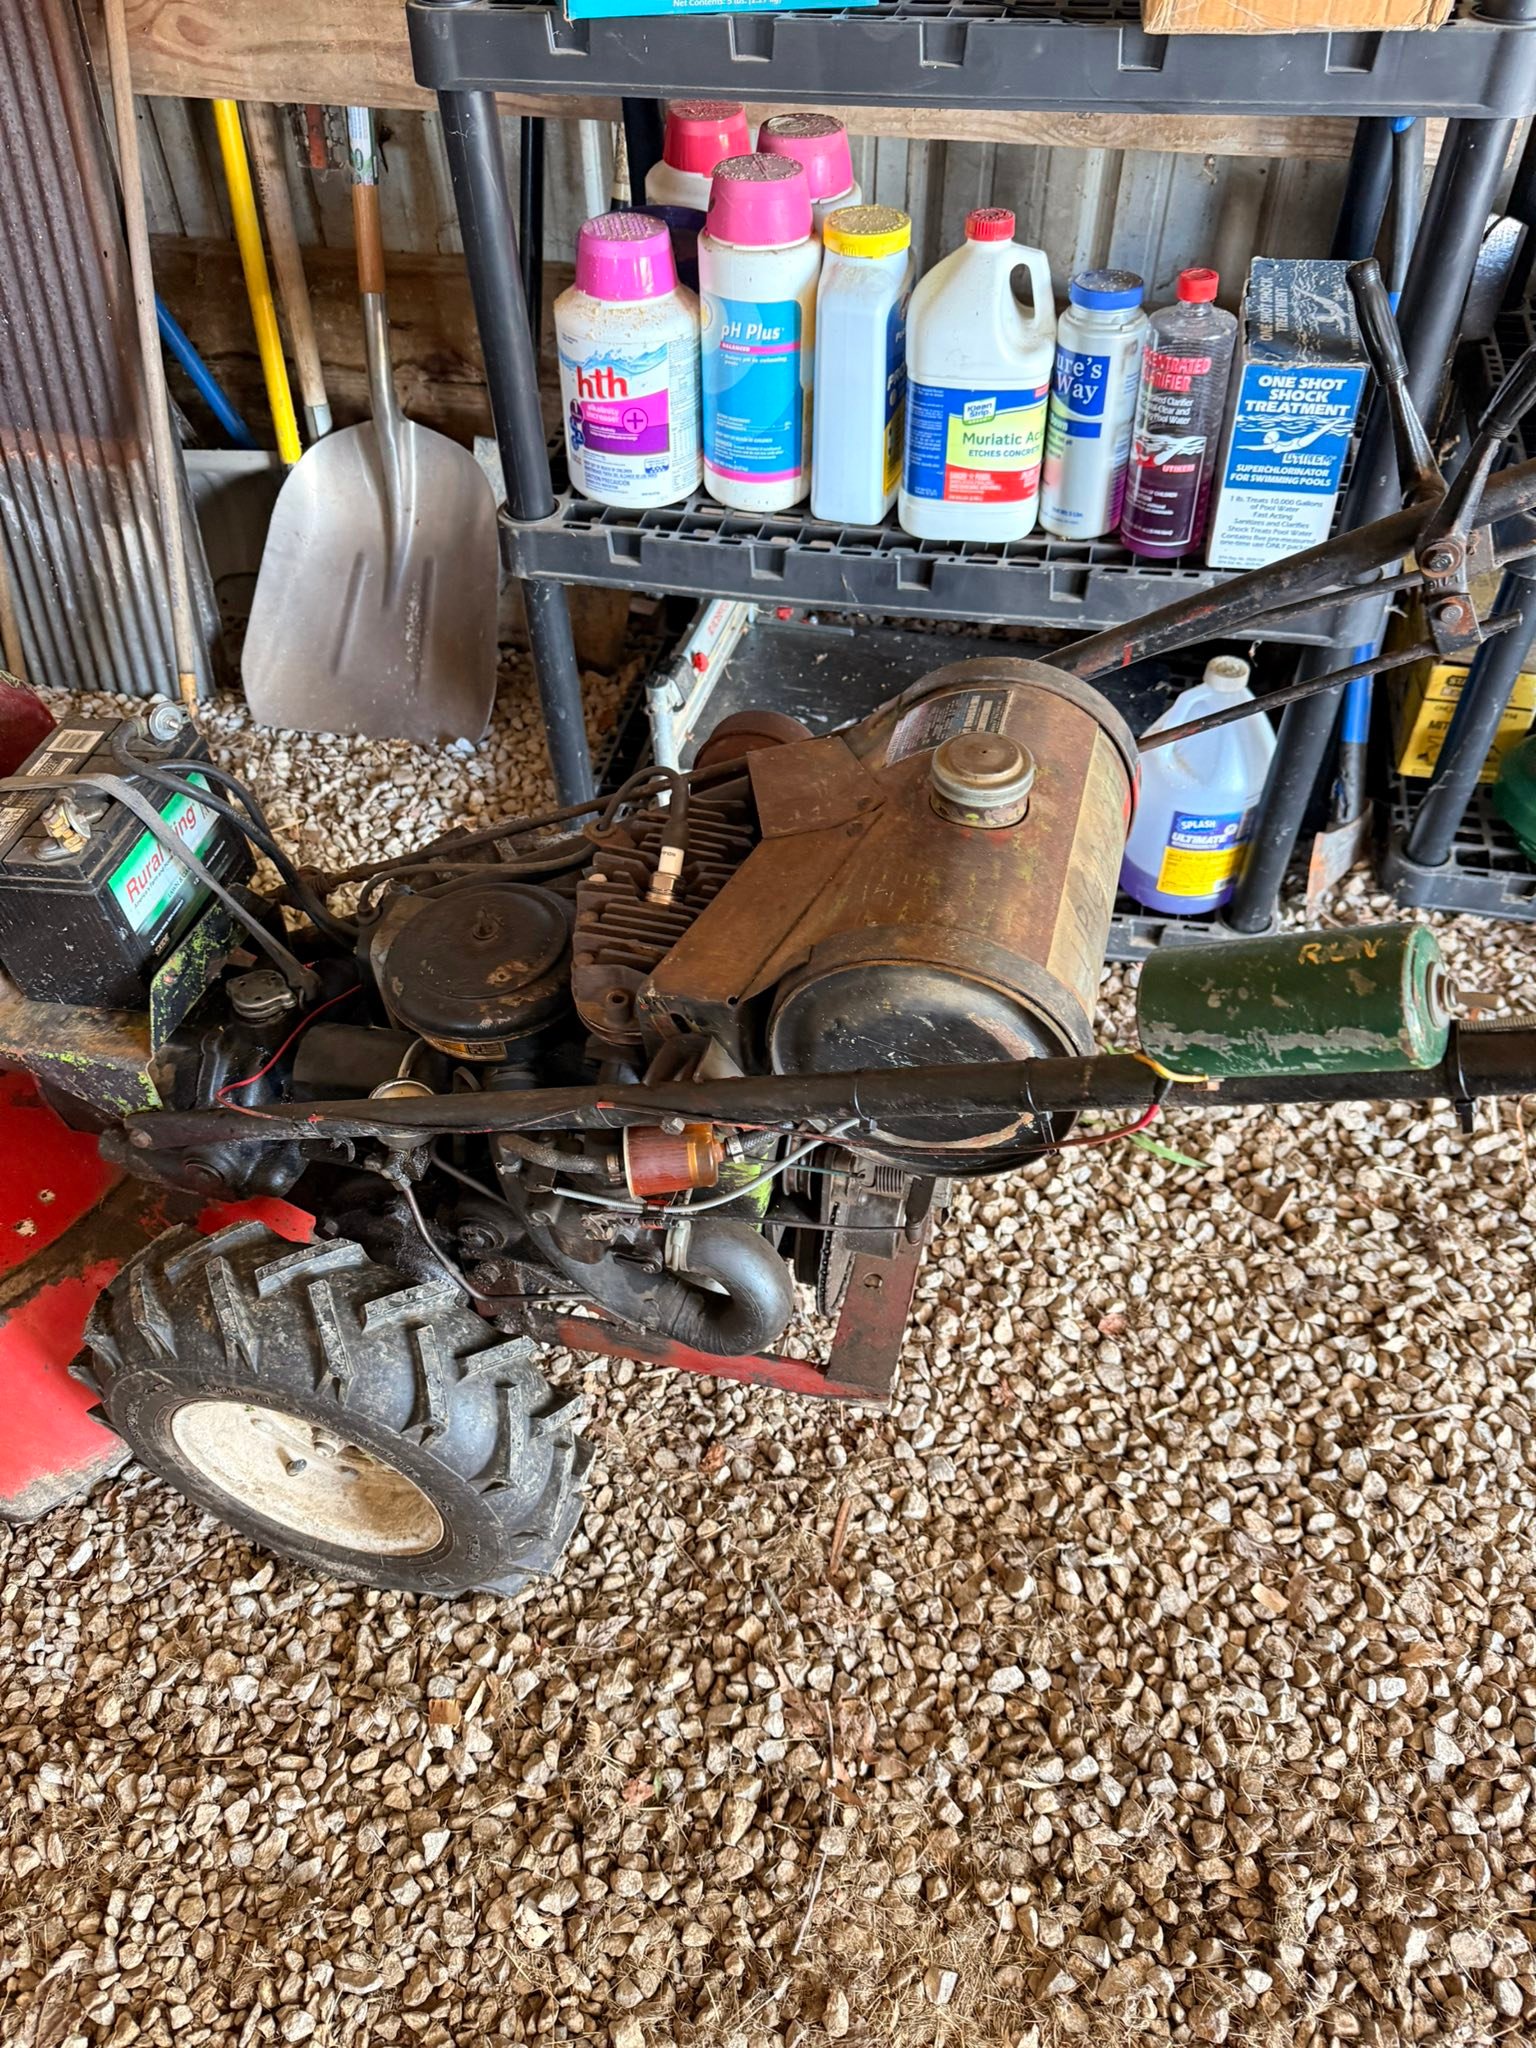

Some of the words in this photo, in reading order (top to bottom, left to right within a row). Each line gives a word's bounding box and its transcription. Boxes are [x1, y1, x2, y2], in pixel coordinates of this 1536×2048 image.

[1260, 277, 1273, 302] SHOCK
[1260, 303, 1273, 323] SHOT
[1275, 287, 1289, 332] TREATMENT
[721, 321, 741, 341] pH
[746, 323, 781, 340] Plus
[1260, 324, 1273, 340] ONE
[1056, 355, 1102, 379] ure's
[576, 366, 629, 399] hth
[1057, 371, 1099, 405] Way
[1258, 375, 1297, 388] ONE
[1298, 377, 1347, 391] SHOT
[1269, 389, 1331, 402] SHOCK
[1245, 400, 1351, 416] TREATMENT
[963, 432, 1022, 445] Muriatic
[1026, 431, 1043, 443] Ac
[1003, 444, 1040, 457] CONCRET
[1235, 464, 1330, 477] SUPERCHLORINATOR
[1230, 473, 1250, 481] FOR
[1250, 474, 1299, 485] SWIMMING
[1299, 478, 1332, 487] POOLS
[1181, 819, 1216, 830] SPLASH
[1172, 831, 1227, 844] ULTIMATE
[125, 843, 164, 904] Rural
